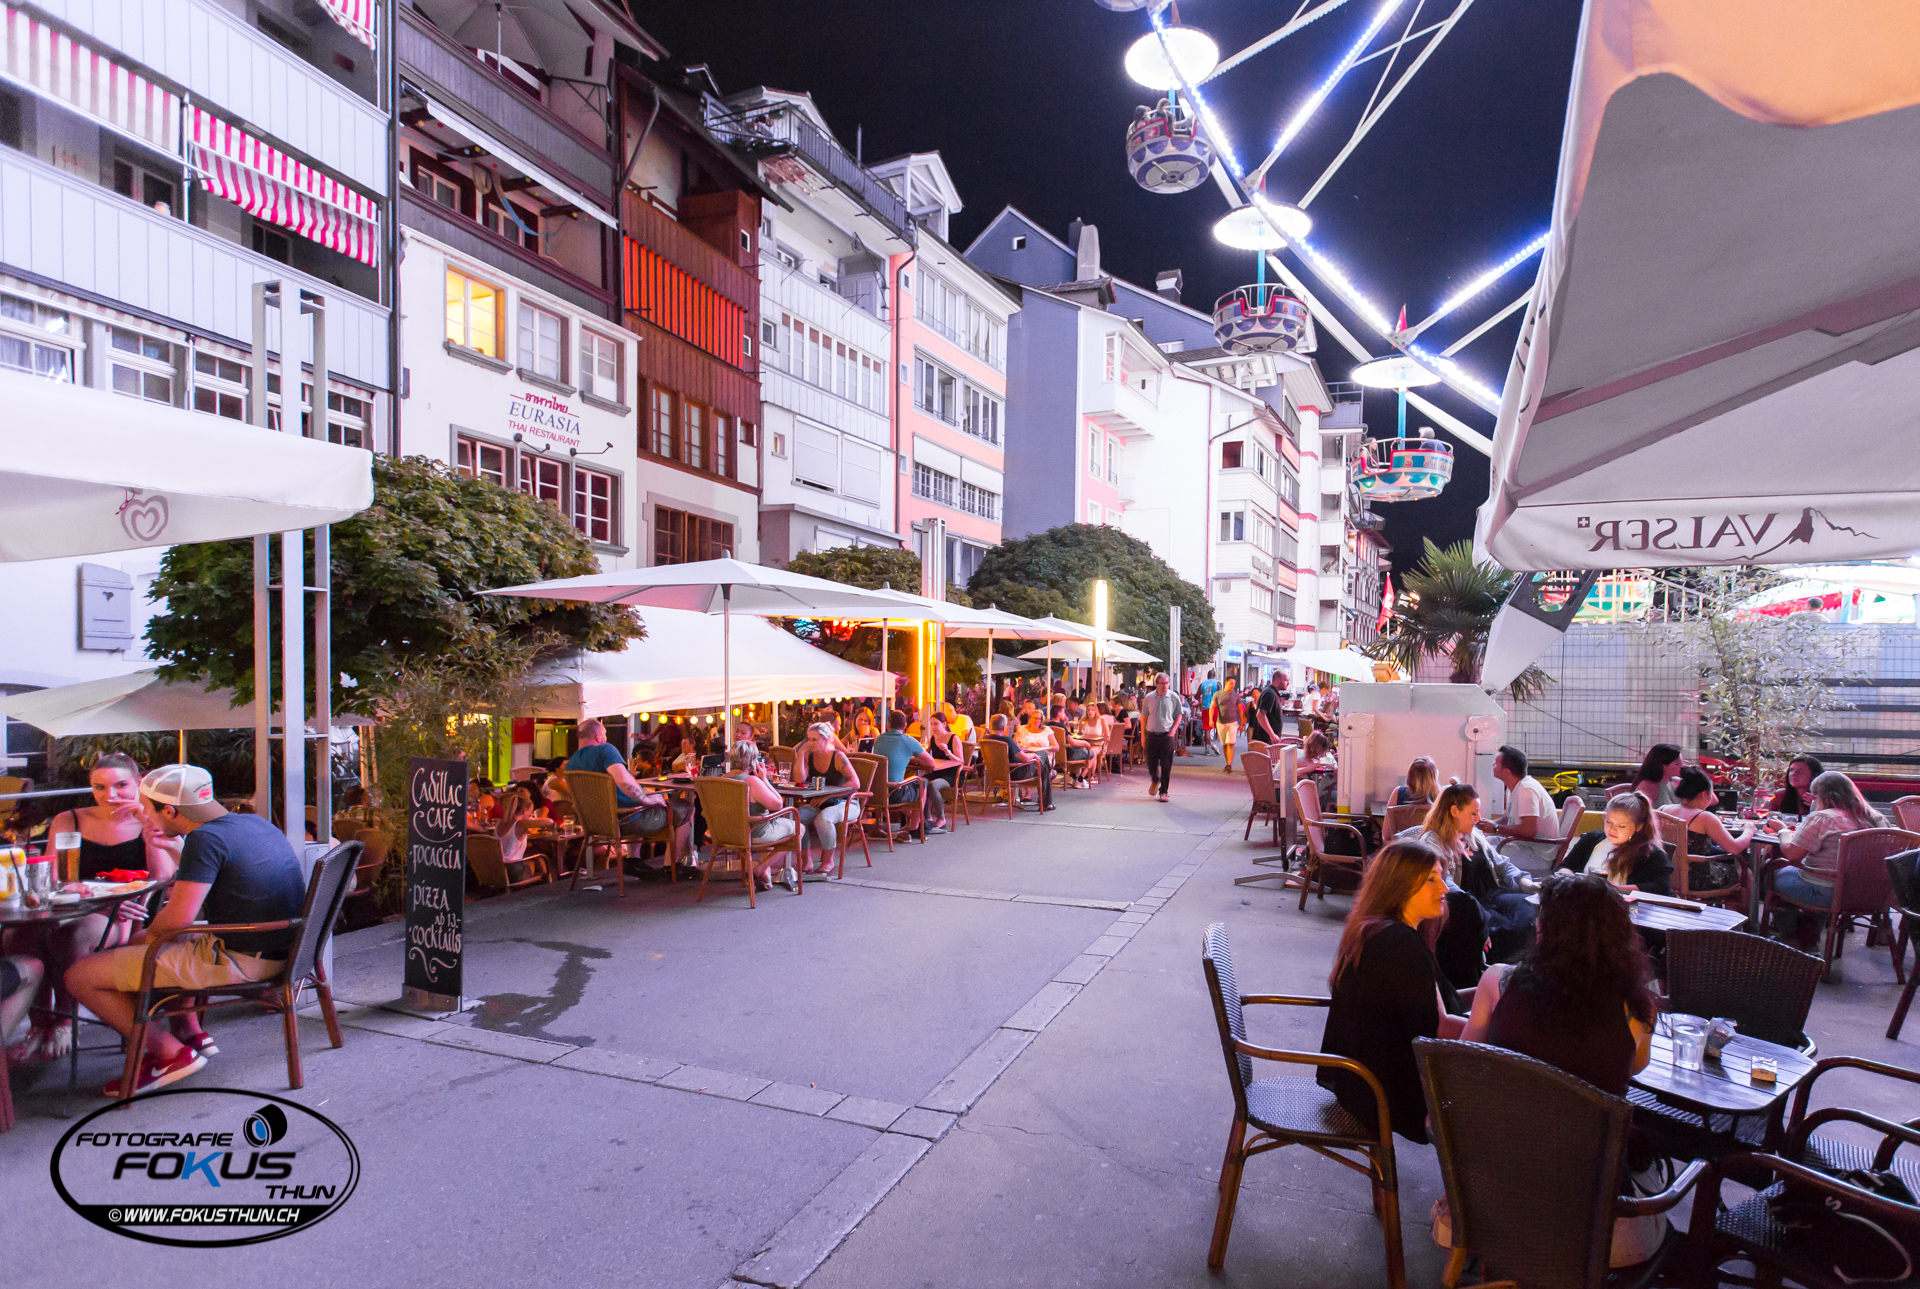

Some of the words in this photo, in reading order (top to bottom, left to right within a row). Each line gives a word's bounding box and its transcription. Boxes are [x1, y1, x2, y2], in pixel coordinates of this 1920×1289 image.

[508, 401, 581, 435] EURASIA
[508, 420, 528, 433] THAI
[529, 426, 581, 447] RESTAURANT
[1403, 455, 1414, 468] 5
